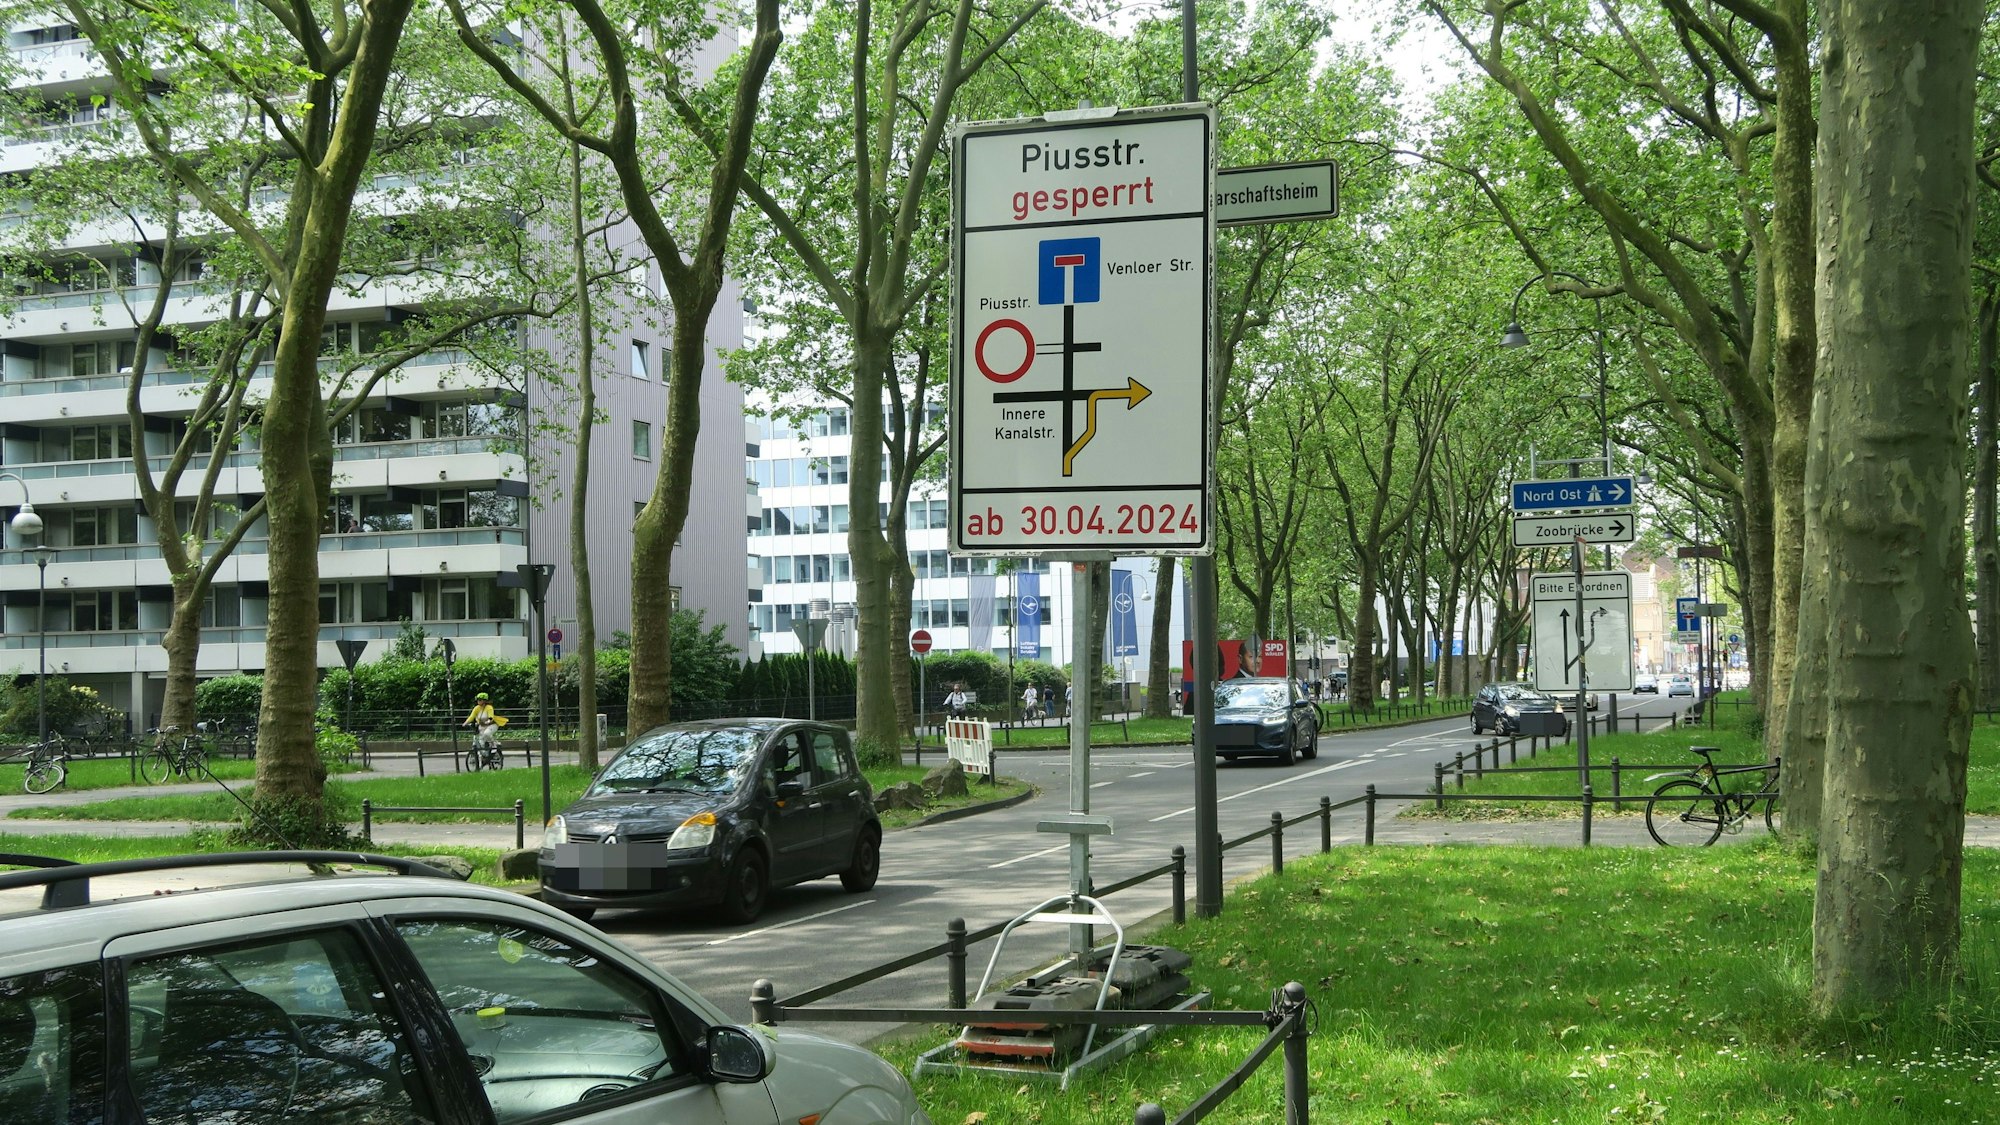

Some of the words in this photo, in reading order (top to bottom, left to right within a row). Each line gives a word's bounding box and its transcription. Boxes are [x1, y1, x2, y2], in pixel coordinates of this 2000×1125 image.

[1022, 139, 1144, 172] Piusstr.
[1012, 177, 1153, 220] gesperrt
[1217, 182, 1318, 206] arschaftsheim
[1107, 261, 1162, 275] Venloer
[1169, 259, 1194, 272] Str.
[980, 296, 1031, 311] Piusstr.
[1002, 408, 1046, 421] Innere
[995, 426, 1055, 440] Kanalstr.
[1523, 490, 1554, 502] Nord
[1560, 488, 1581, 500] Ost
[967, 507, 1004, 536] ab
[1020, 503, 1198, 536] 30.04.2024
[1536, 524, 1604, 537] Zoobrücke
[1539, 583, 1564, 594] Bitte
[1568, 581, 1622, 593] Eordnen
[1264, 643, 1284, 652] SPD
